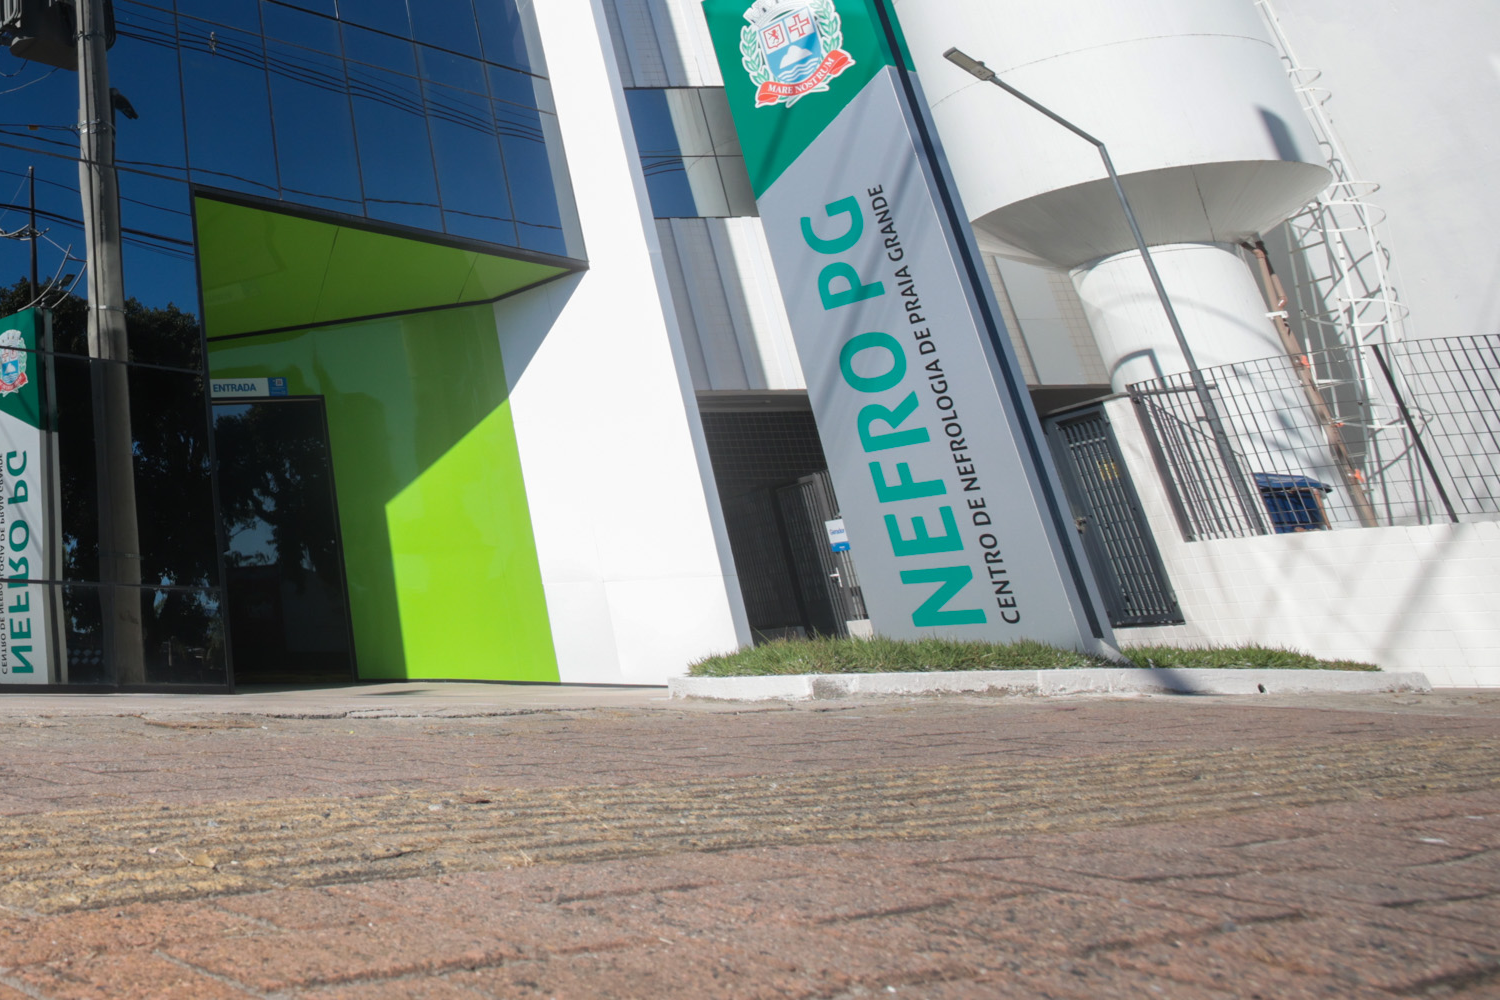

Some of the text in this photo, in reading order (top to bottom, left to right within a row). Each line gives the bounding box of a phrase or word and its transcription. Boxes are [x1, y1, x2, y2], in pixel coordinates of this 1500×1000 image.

[767, 57, 835, 94] MARE NOSTRUM
[213, 383, 257, 392] ENTRADA
[800, 195, 987, 627] NEFRO PG
[867, 184, 1021, 624] CENTRO DE NEFROLOGIA DE PRAIA GRANDE
